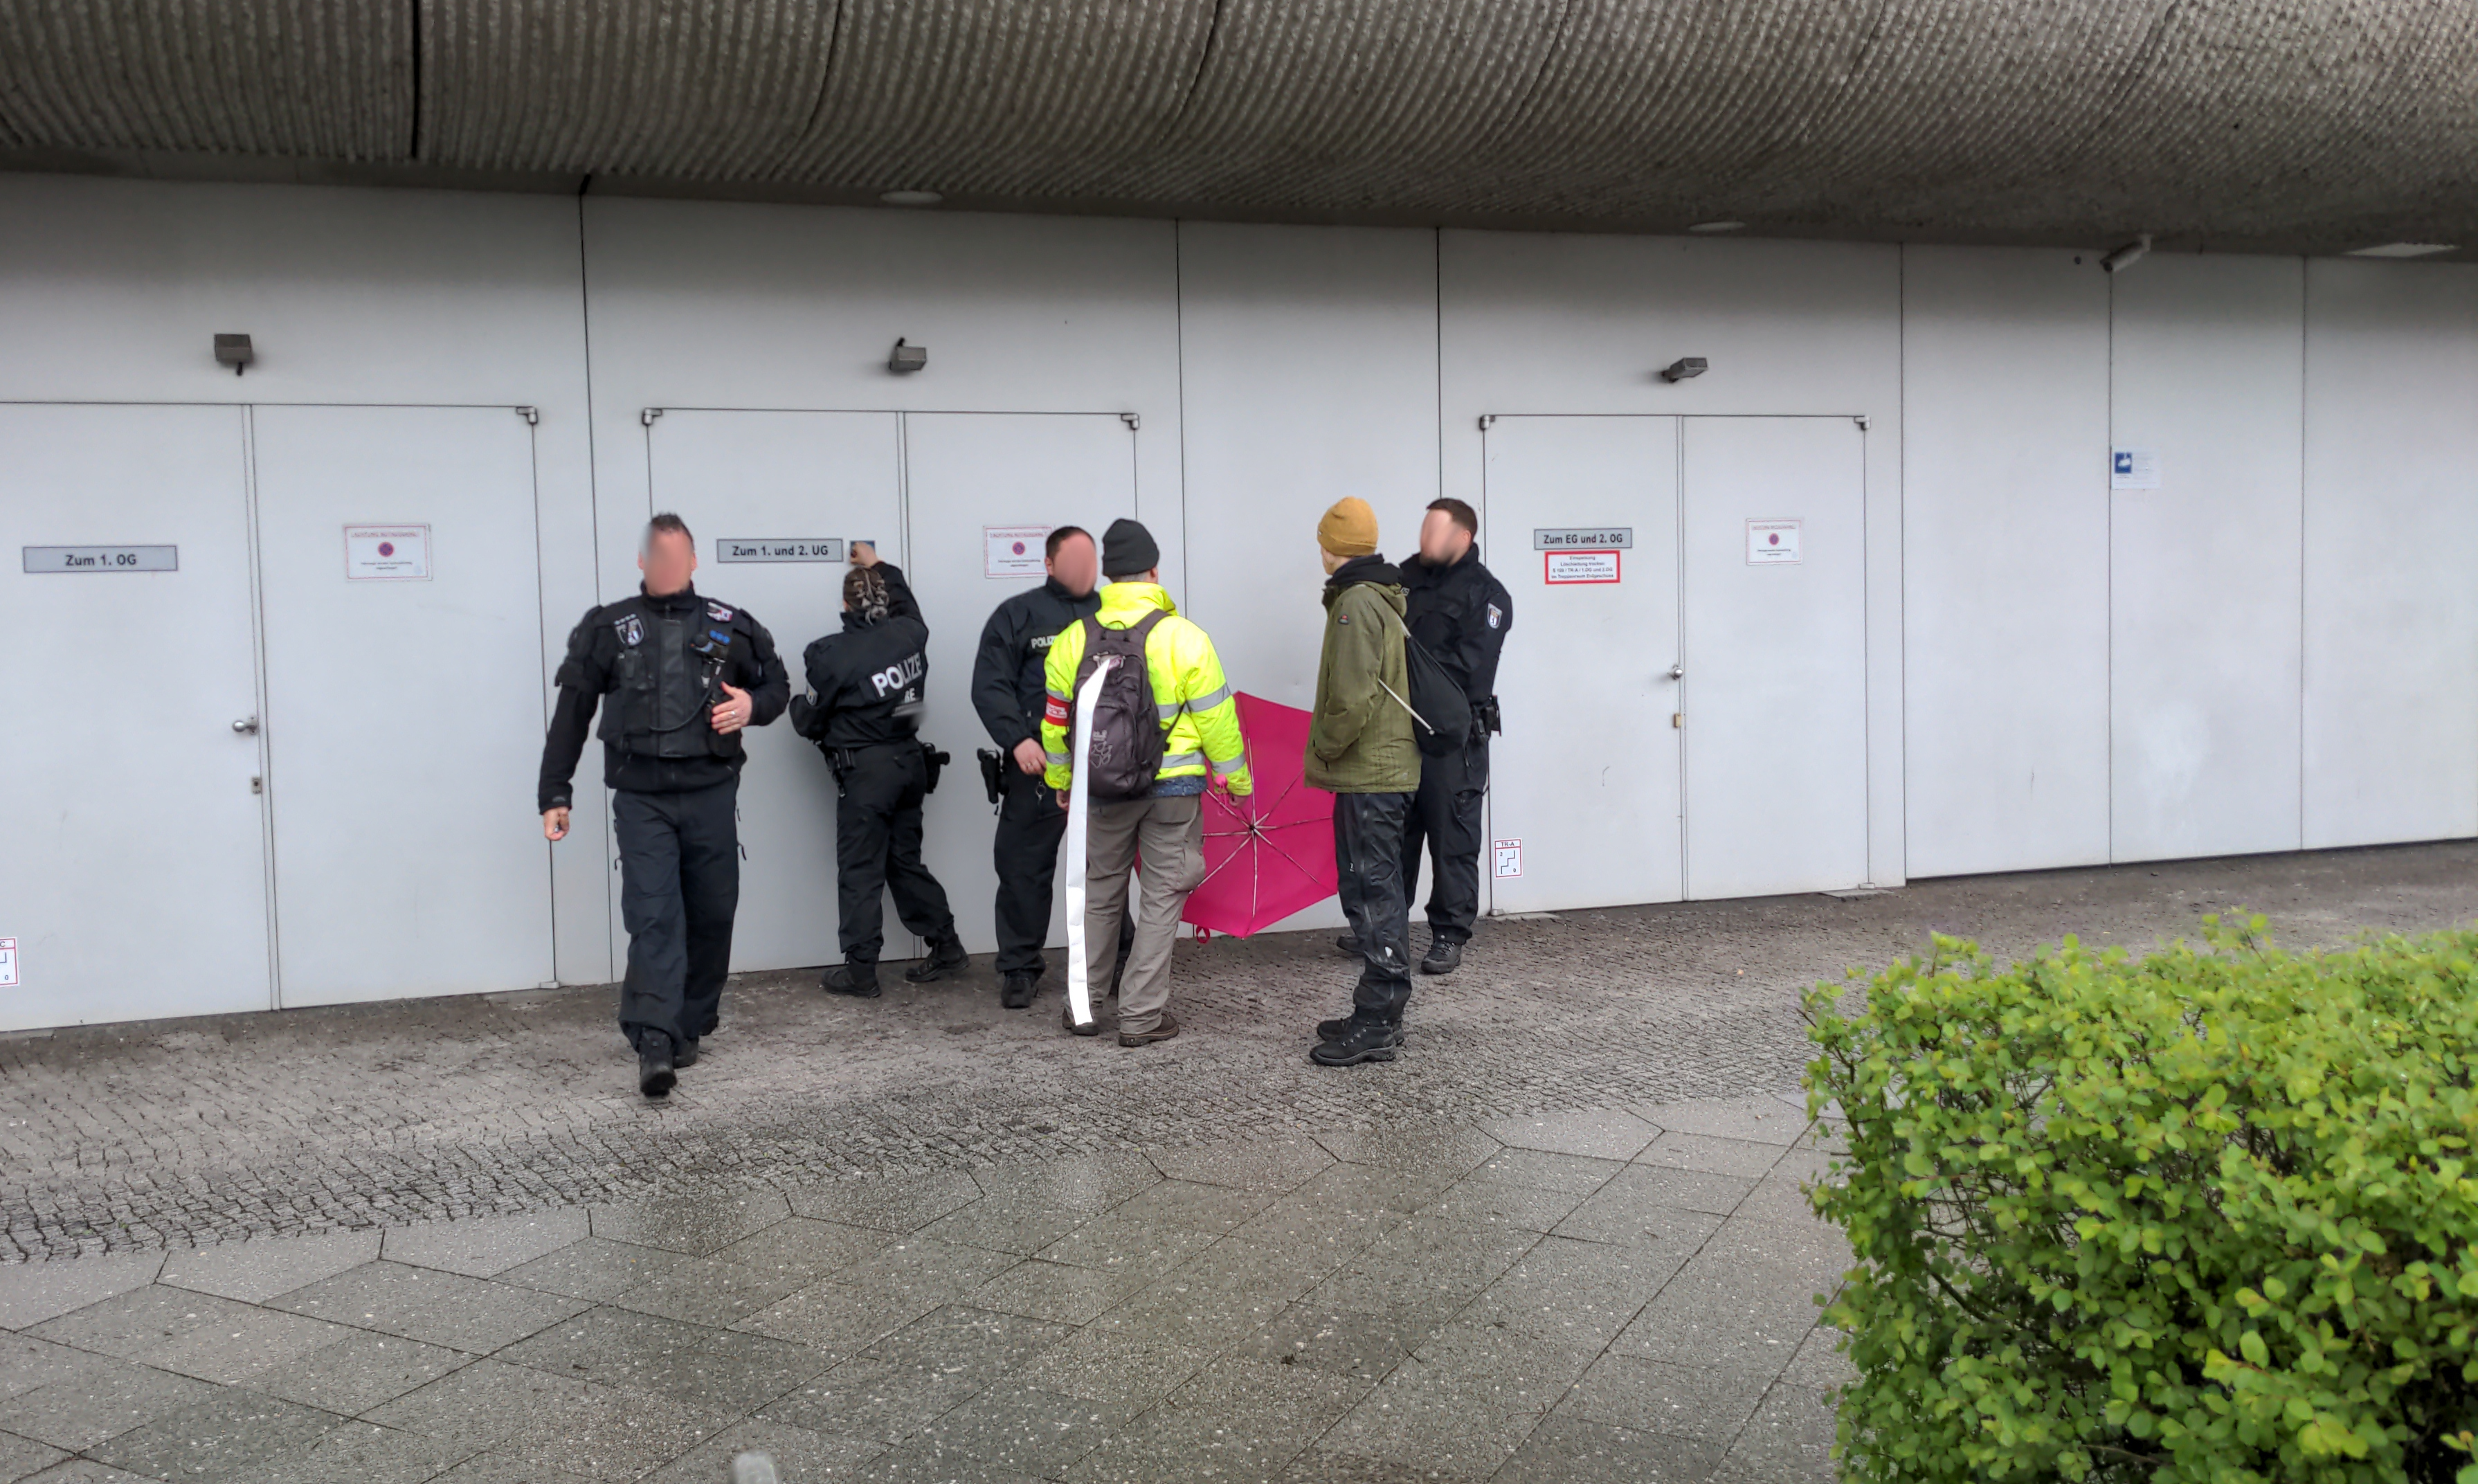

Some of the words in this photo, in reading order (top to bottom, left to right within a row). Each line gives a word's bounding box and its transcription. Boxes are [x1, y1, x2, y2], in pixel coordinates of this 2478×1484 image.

[1544, 534, 1563, 544] Zum
[1566, 534, 1577, 543] EG
[1581, 534, 1596, 543] und
[1599, 534, 1607, 543] 2.
[1610, 534, 1622, 543] OG
[732, 545, 757, 556] Zum
[761, 545, 771, 556] 1.
[775, 545, 795, 556] und
[799, 545, 808, 555] 2.
[812, 545, 829, 555] UG
[65, 554, 95, 566] Zum
[100, 554, 111, 565] 1.
[116, 554, 136, 565] OG
[1031, 635, 1058, 649] POLIZ
